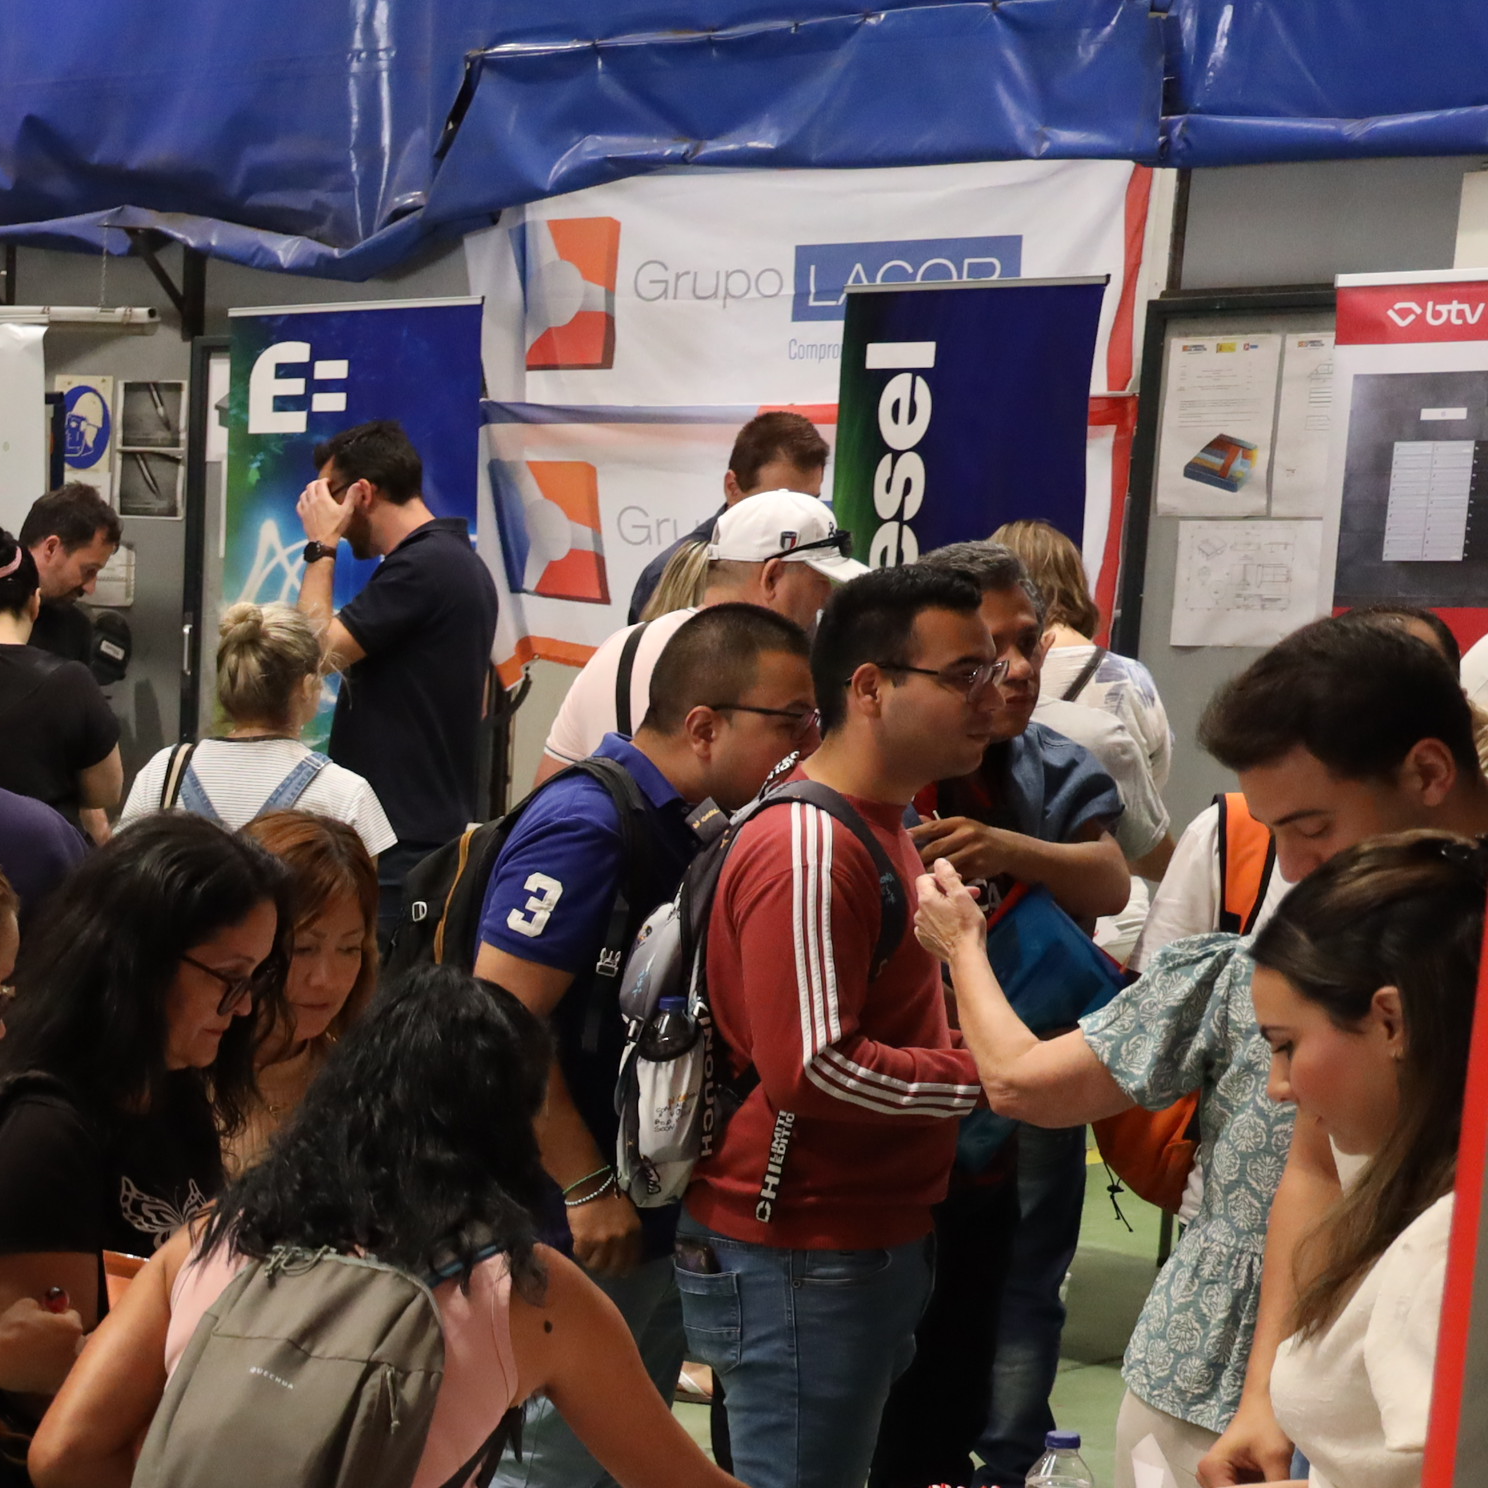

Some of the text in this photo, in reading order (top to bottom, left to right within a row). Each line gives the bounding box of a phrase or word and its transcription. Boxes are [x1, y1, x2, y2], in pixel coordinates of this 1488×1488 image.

[633, 259, 784, 309] Grupo
[1426, 299, 1486, 326] btv
[788, 338, 841, 364] Compro
[506, 871, 564, 938] 3
[249, 1365, 295, 1391] QUECHUA
